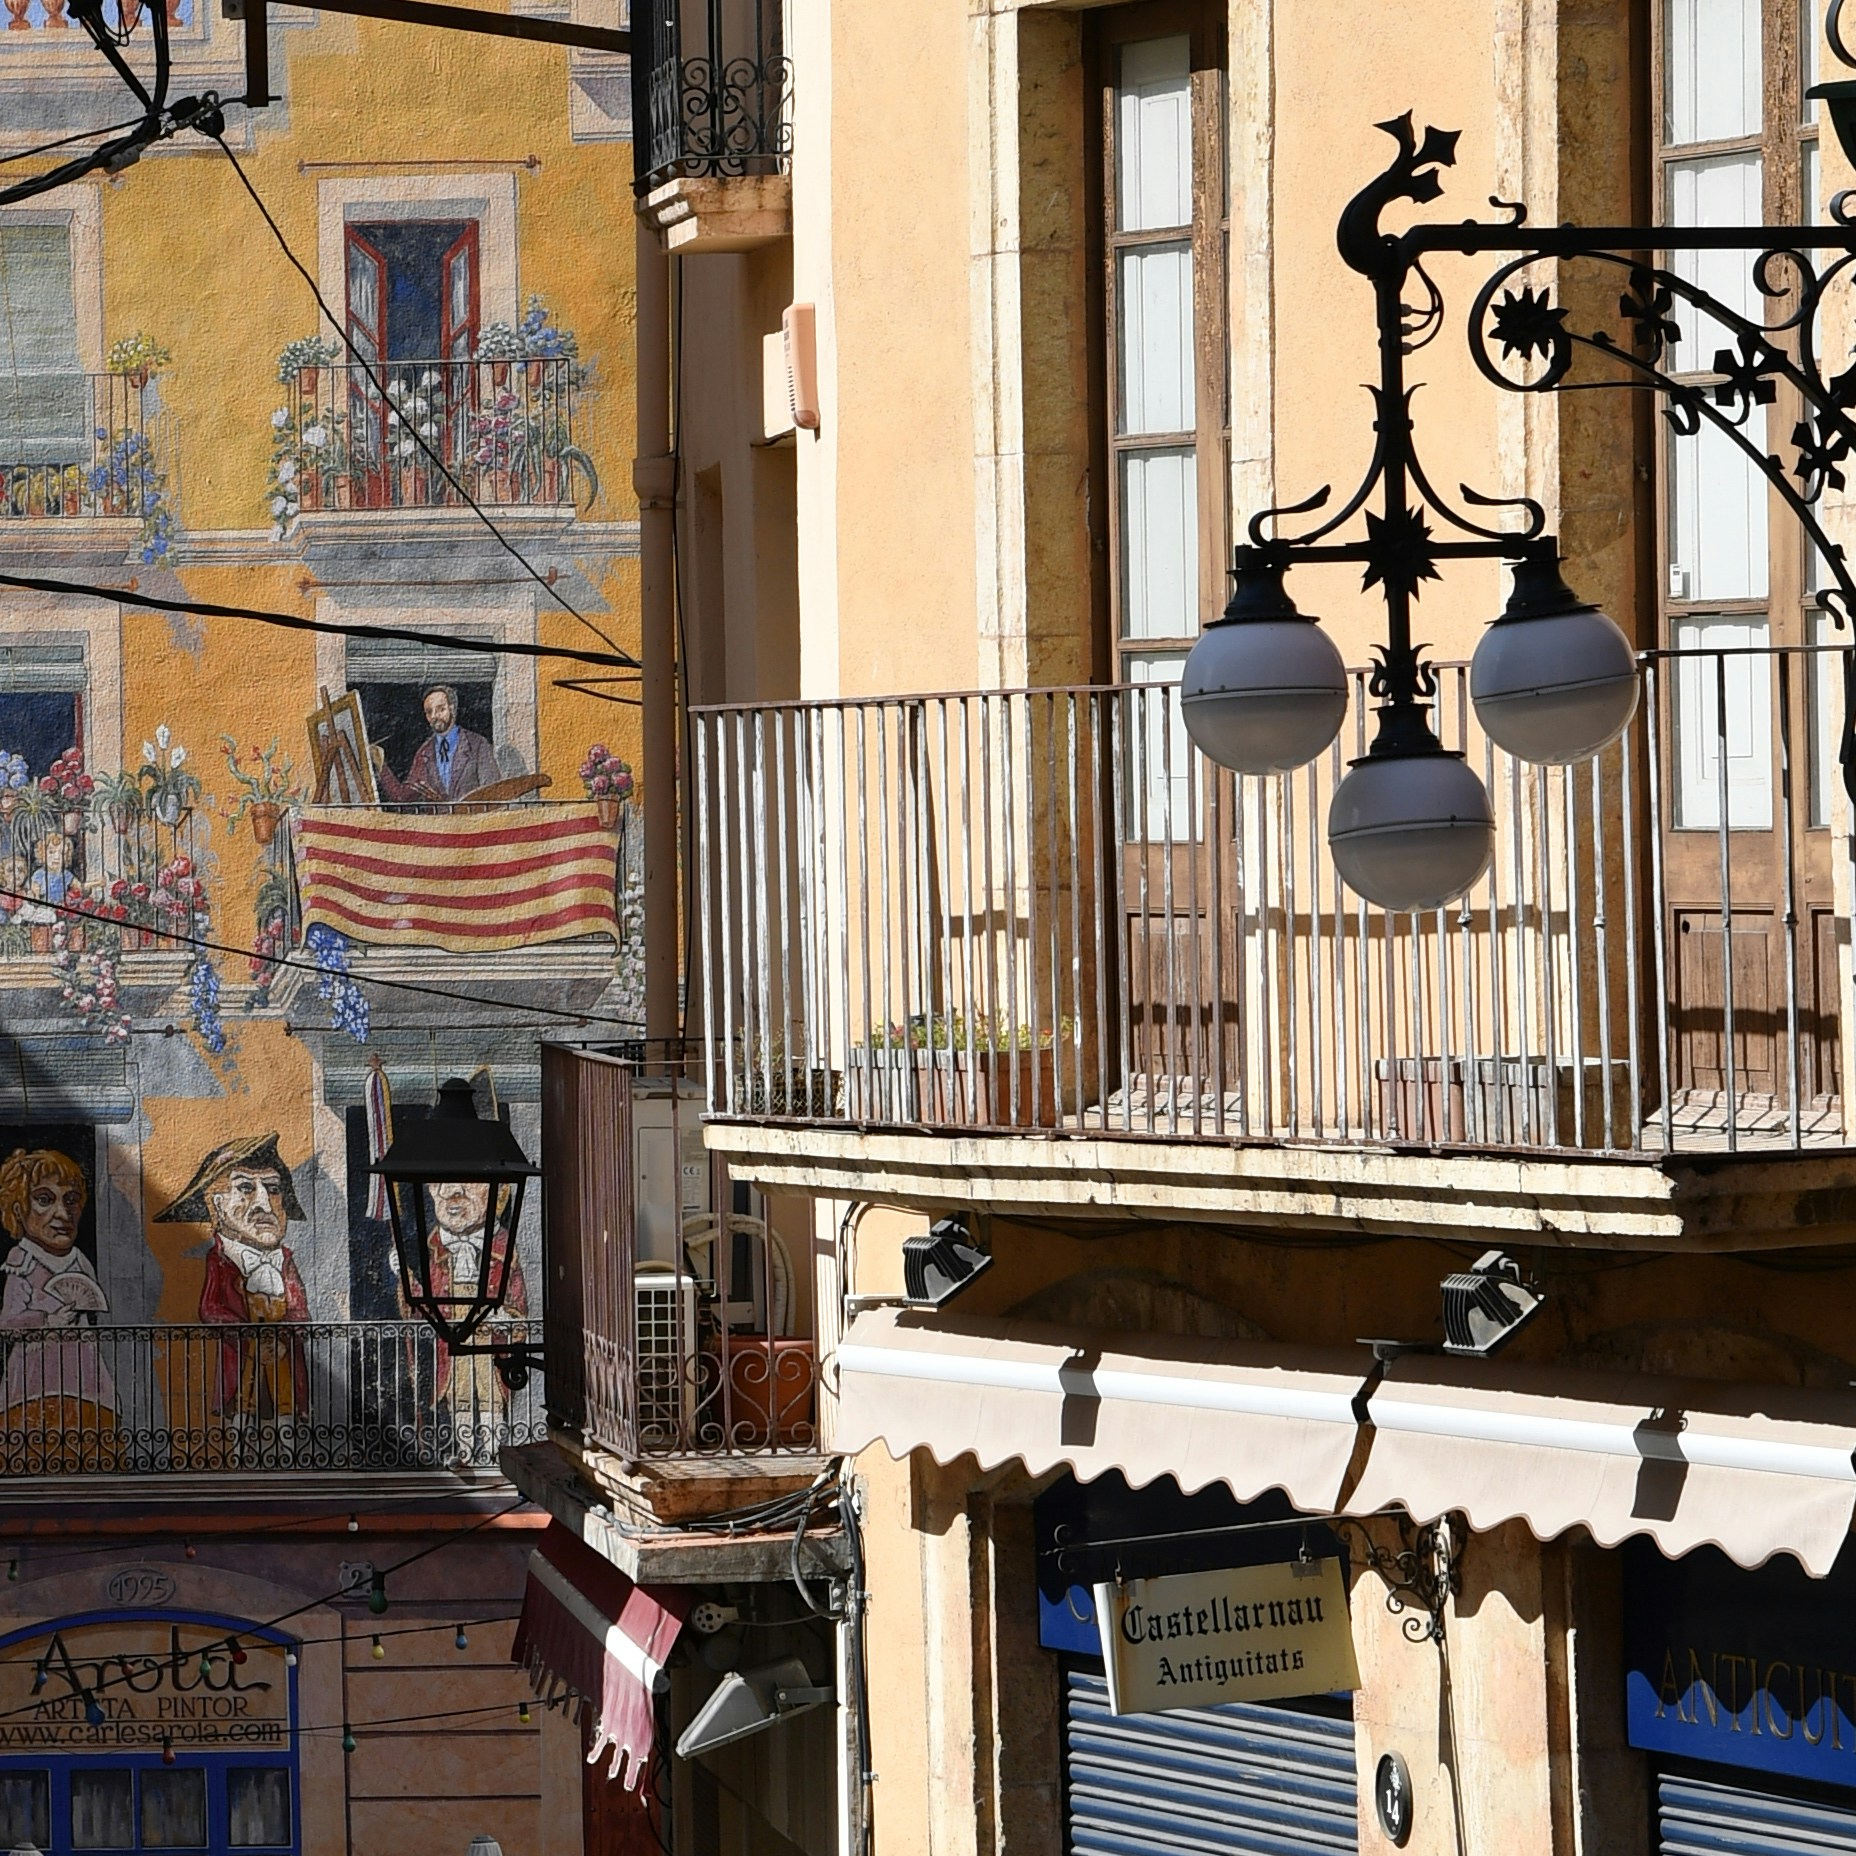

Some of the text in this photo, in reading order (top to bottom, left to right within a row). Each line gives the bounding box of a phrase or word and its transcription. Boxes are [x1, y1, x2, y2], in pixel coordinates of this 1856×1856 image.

[111, 1575, 169, 1602] 1995
[350, 1569, 364, 1590] 2
[1121, 1595, 1325, 1645] Castellarnau
[1156, 1648, 1304, 1686] Antiguitats
[33, 1696, 252, 1721] ARTTA PINTOR
[1385, 1788, 1400, 1825] 14
